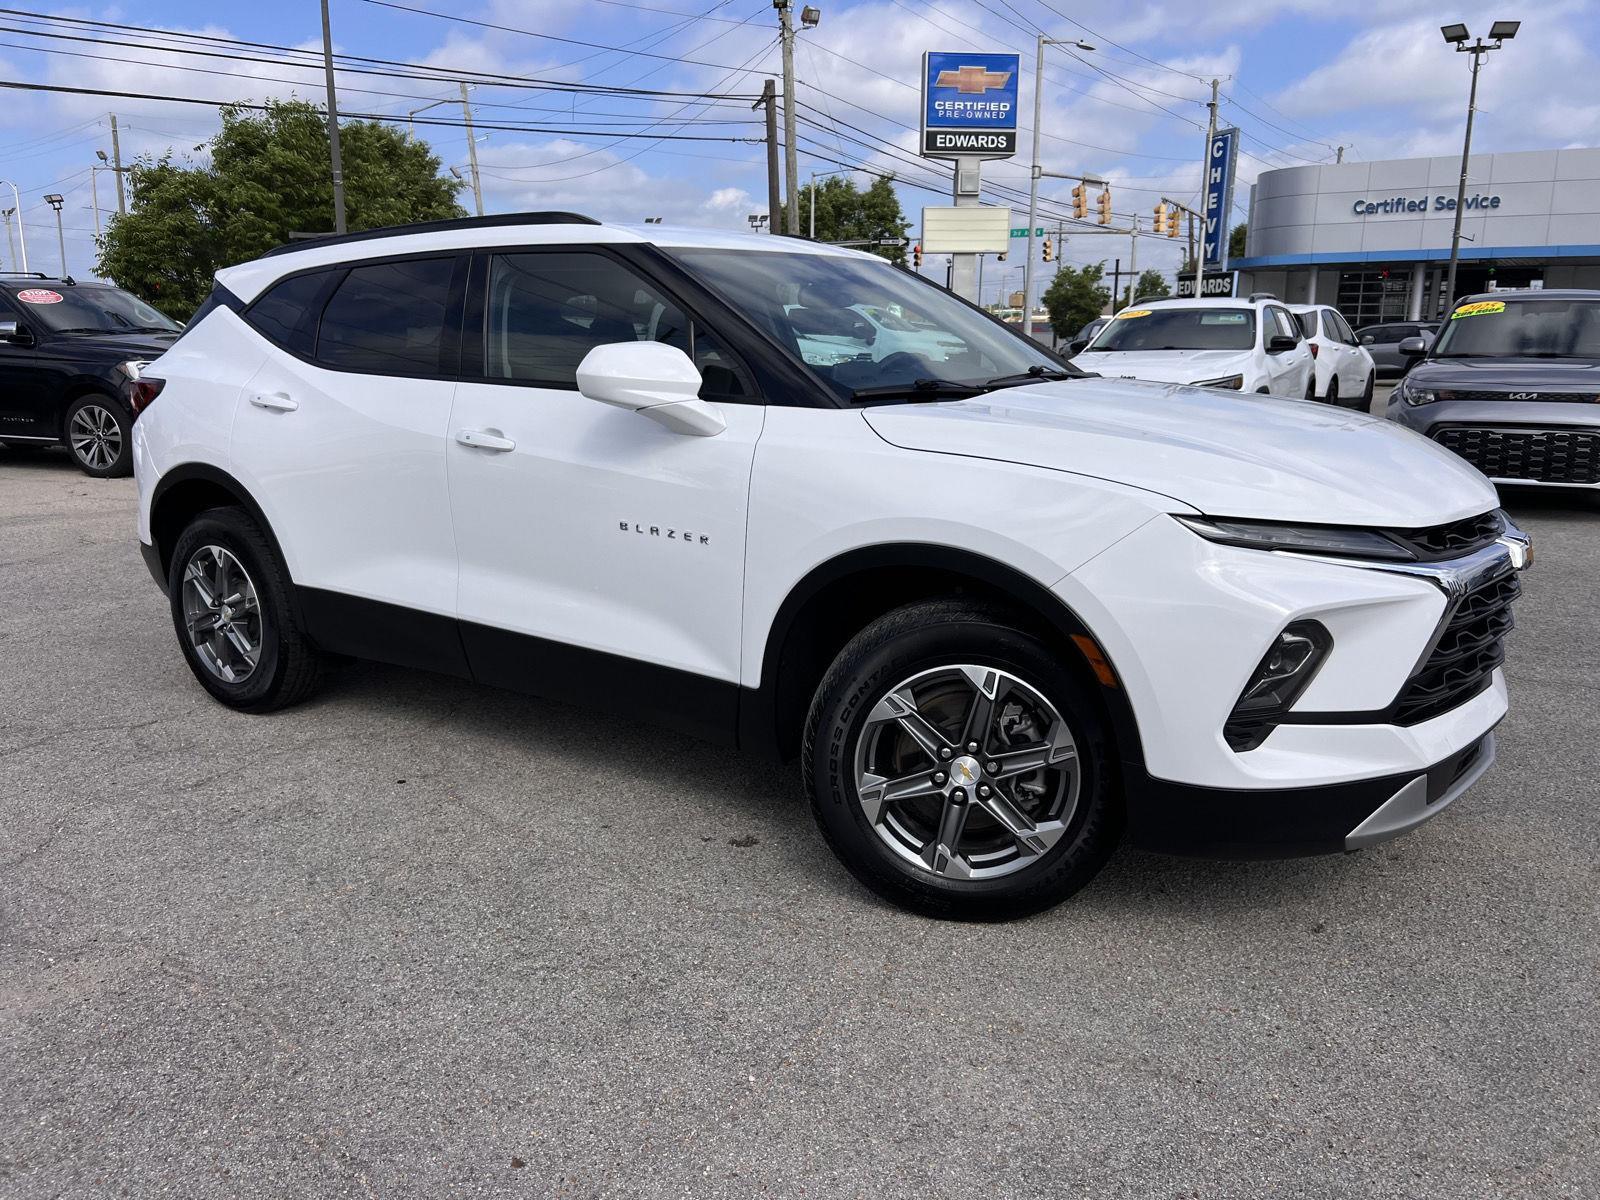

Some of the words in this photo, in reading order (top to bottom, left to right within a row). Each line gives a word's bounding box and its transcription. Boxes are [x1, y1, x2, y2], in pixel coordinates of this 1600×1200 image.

[934, 101, 1010, 111] CERTIFIED
[938, 111, 1006, 119] PRE-OWNED
[936, 134, 1007, 148] EDWARDS
[1205, 141, 1224, 259] CHEVY
[1353, 196, 1429, 215] Certified
[1434, 194, 1501, 211] Sevice
[619, 521, 710, 545] BLAZER
[829, 726, 844, 806] CROSS
